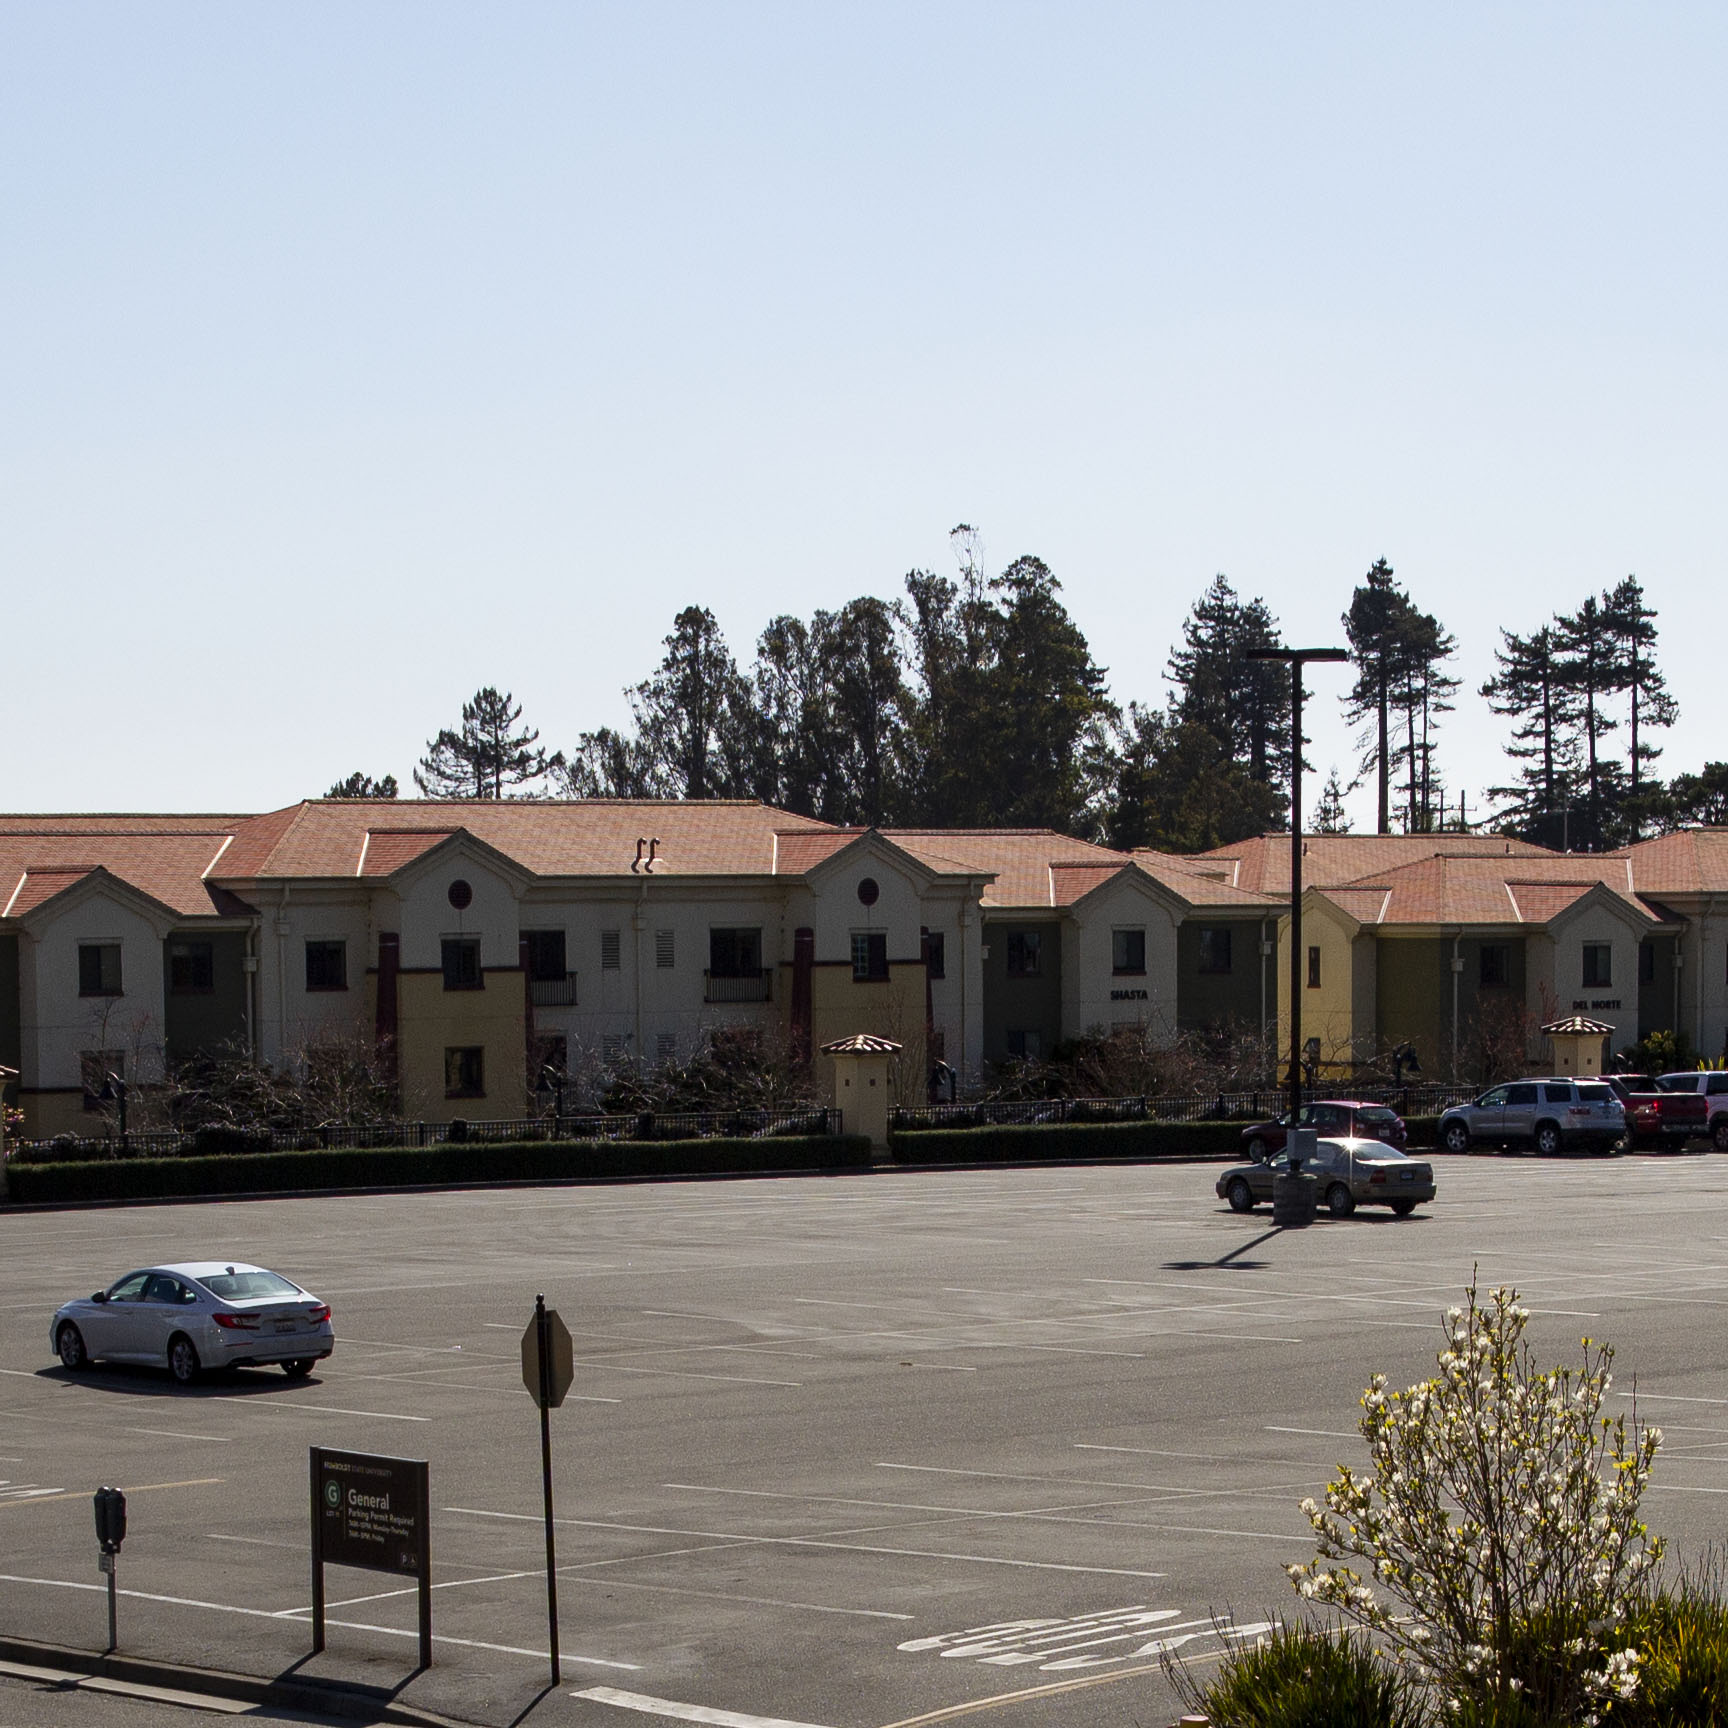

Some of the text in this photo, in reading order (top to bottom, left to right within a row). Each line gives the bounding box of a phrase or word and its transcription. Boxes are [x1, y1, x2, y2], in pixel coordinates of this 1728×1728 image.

[328, 1485, 338, 1503] G
[348, 1488, 390, 1511] General
[348, 1507, 370, 1521] Parking
[370, 1510, 389, 1522] Permit
[389, 1513, 415, 1527] Required
[897, 1605, 1282, 1671] STOP
